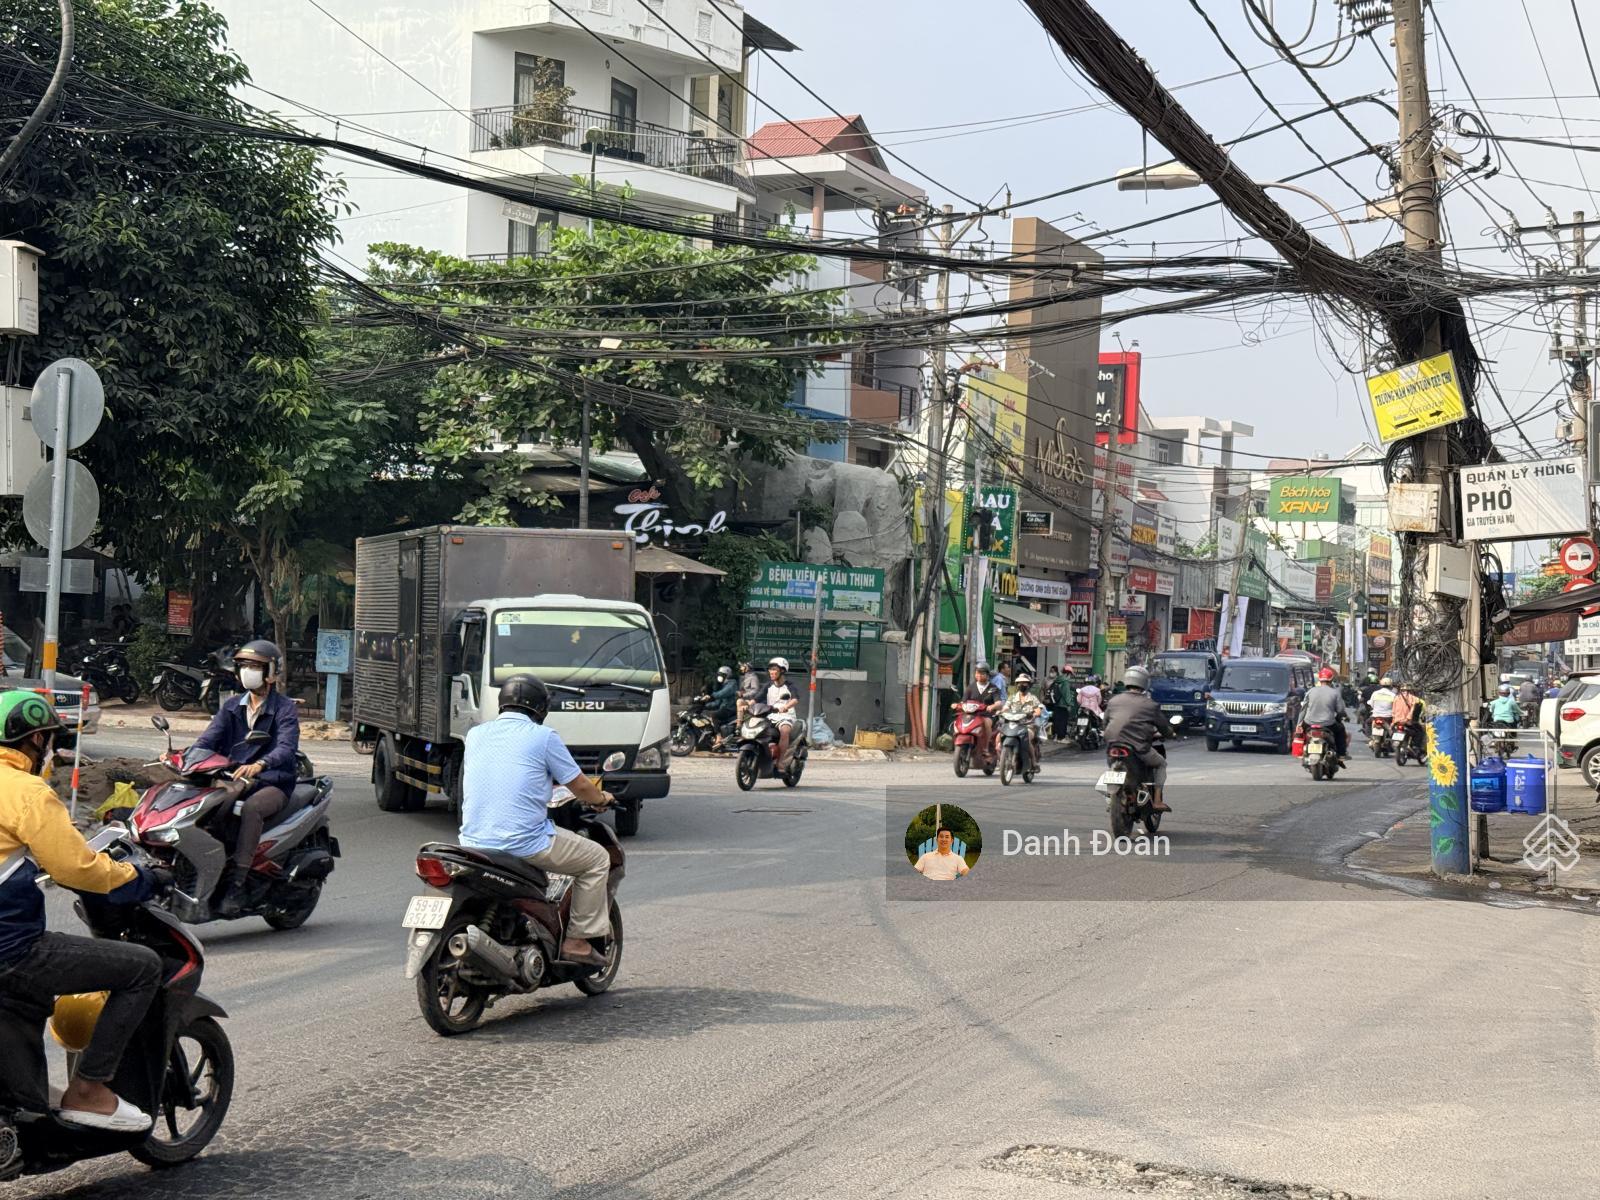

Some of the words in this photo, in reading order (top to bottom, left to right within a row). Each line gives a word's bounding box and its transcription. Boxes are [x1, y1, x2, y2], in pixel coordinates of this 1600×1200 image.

[1467, 466, 1506, 484] QUÁN
[1512, 466, 1529, 479] LÝ
[1280, 486, 1309, 498] Bách
[1310, 486, 1331, 498] hóa
[1467, 484, 1512, 512] PHỞ
[972, 493, 1011, 509] RAU
[1278, 501, 1330, 514] XANH
[1467, 517, 1476, 527] GIA
[769, 565, 793, 584] BỆNH
[830, 570, 847, 586] VĂN
[850, 573, 875, 590] THỊNH
[1070, 605, 1088, 622] SPA
[561, 701, 605, 710] ISUZU
